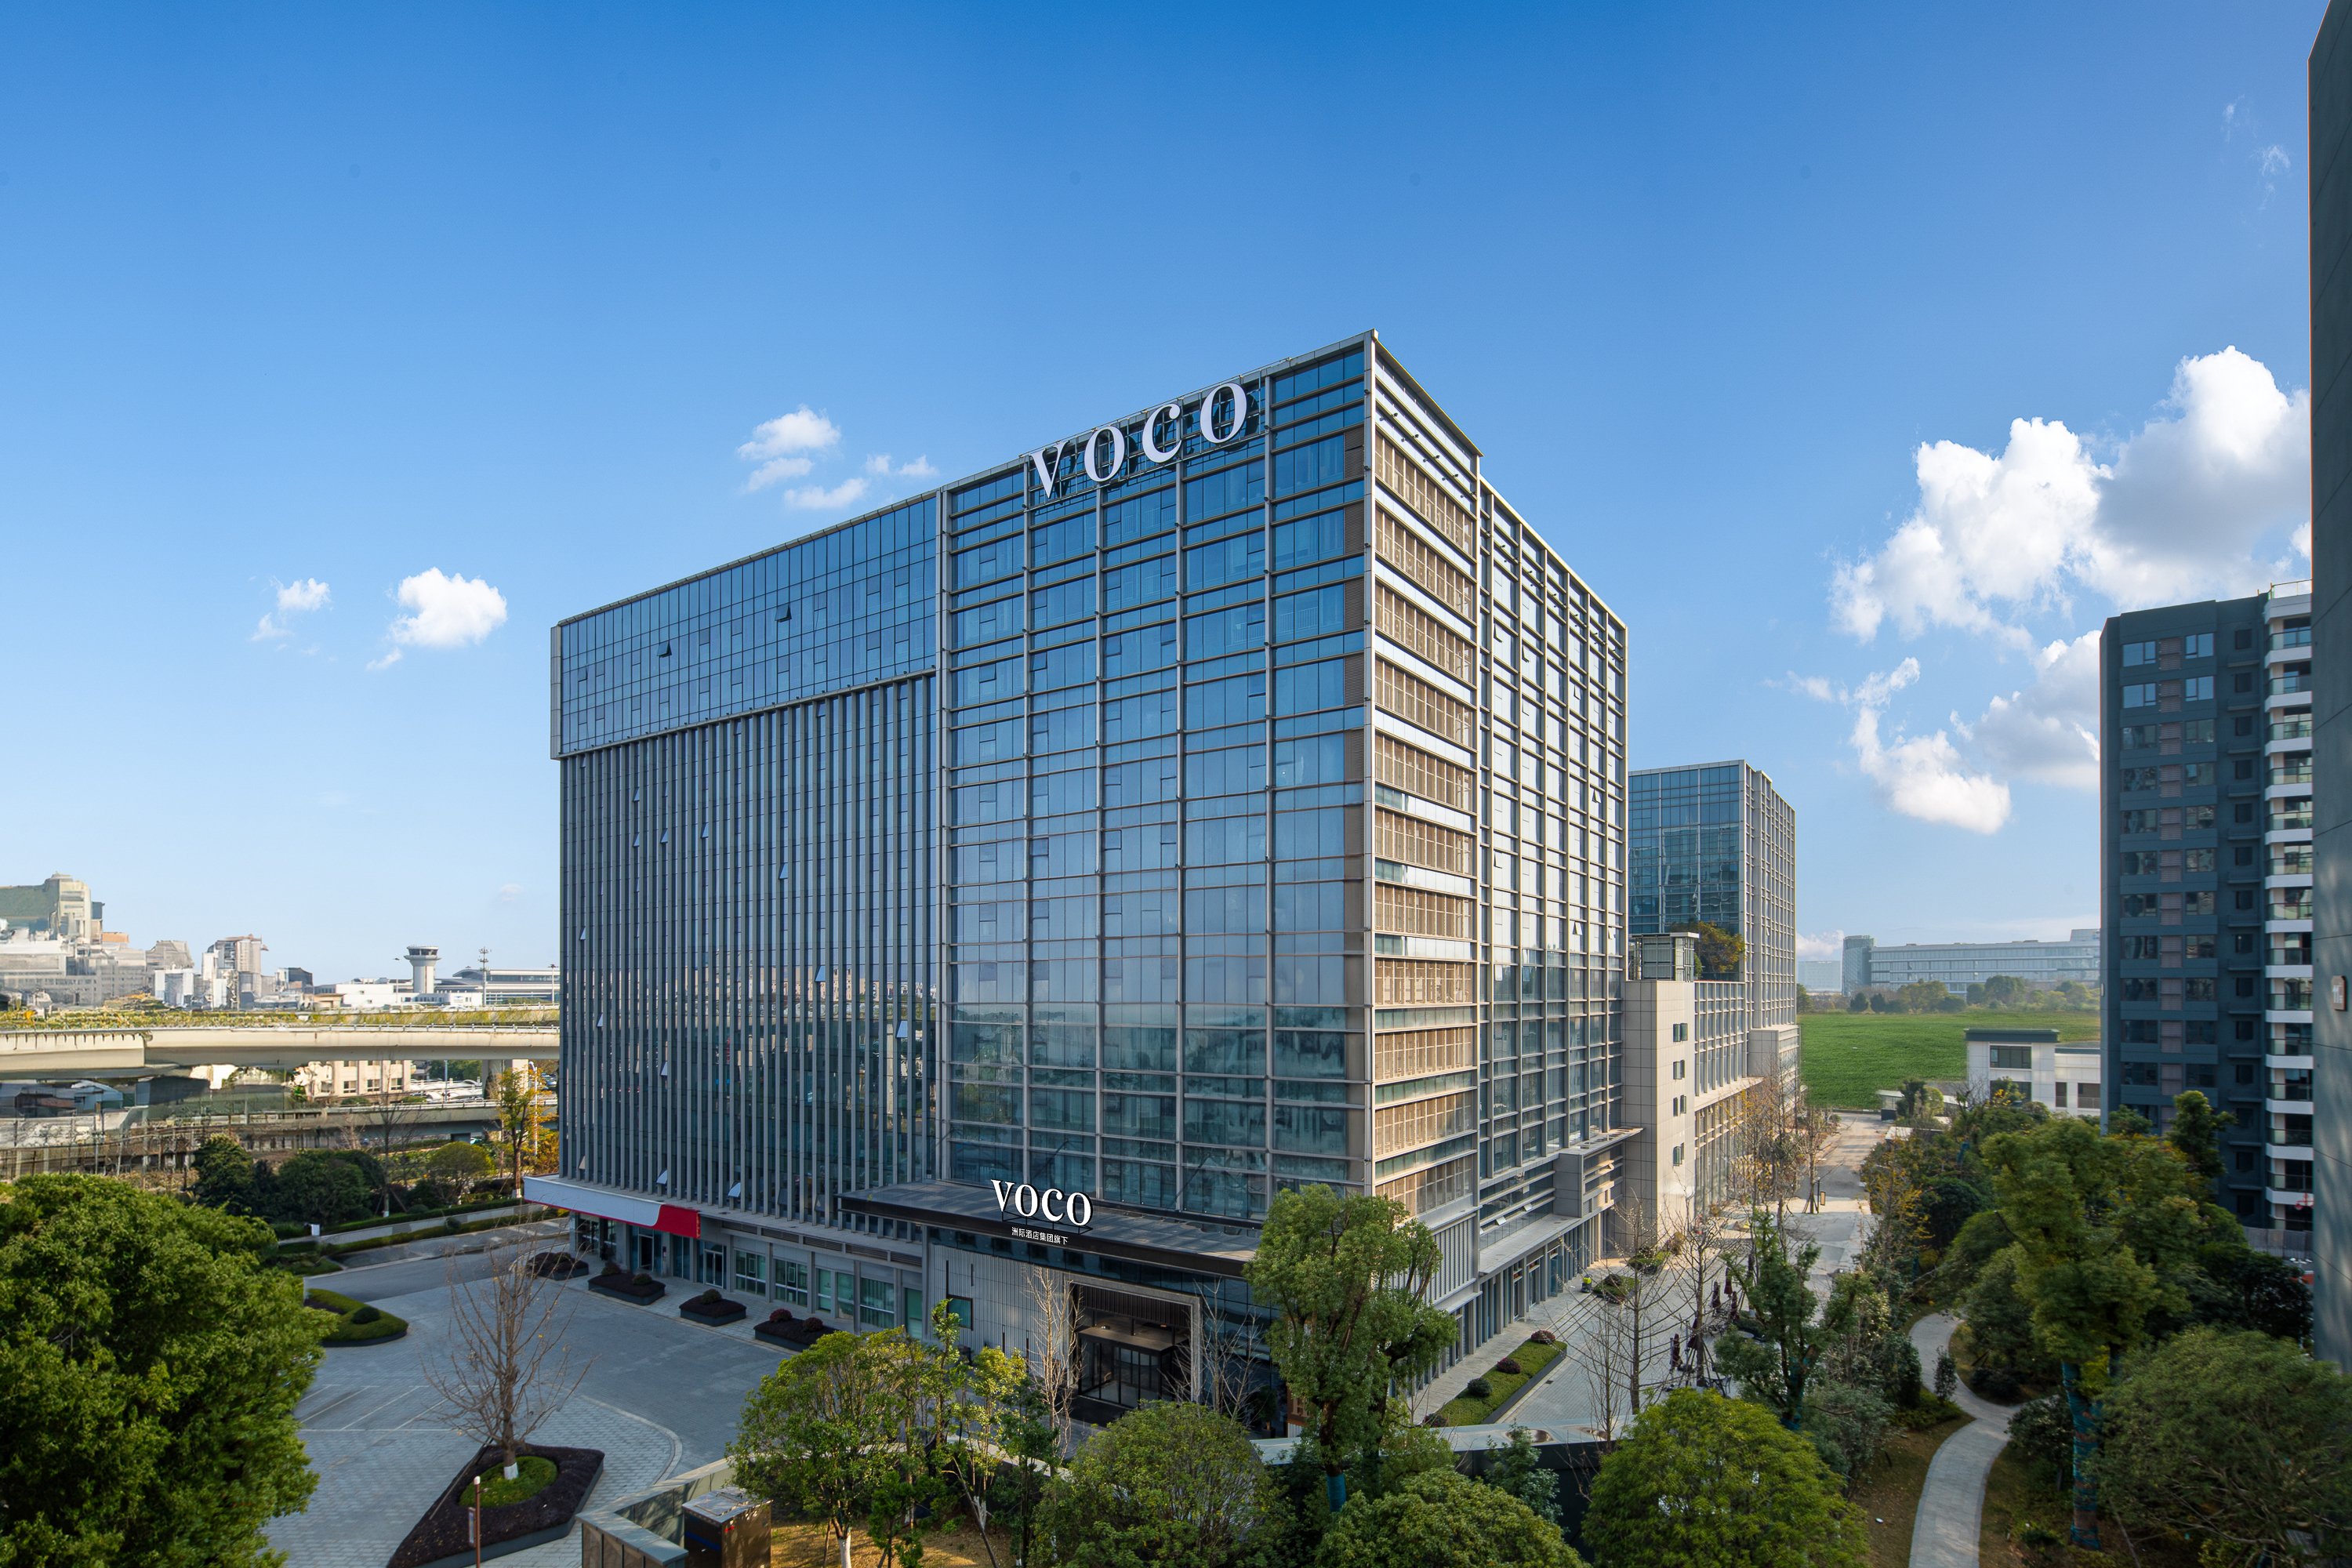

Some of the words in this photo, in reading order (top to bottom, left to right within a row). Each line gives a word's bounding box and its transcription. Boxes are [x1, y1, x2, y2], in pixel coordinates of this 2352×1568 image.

[1011, 1226, 1069, 1245] 洲际酒店集团旗下
